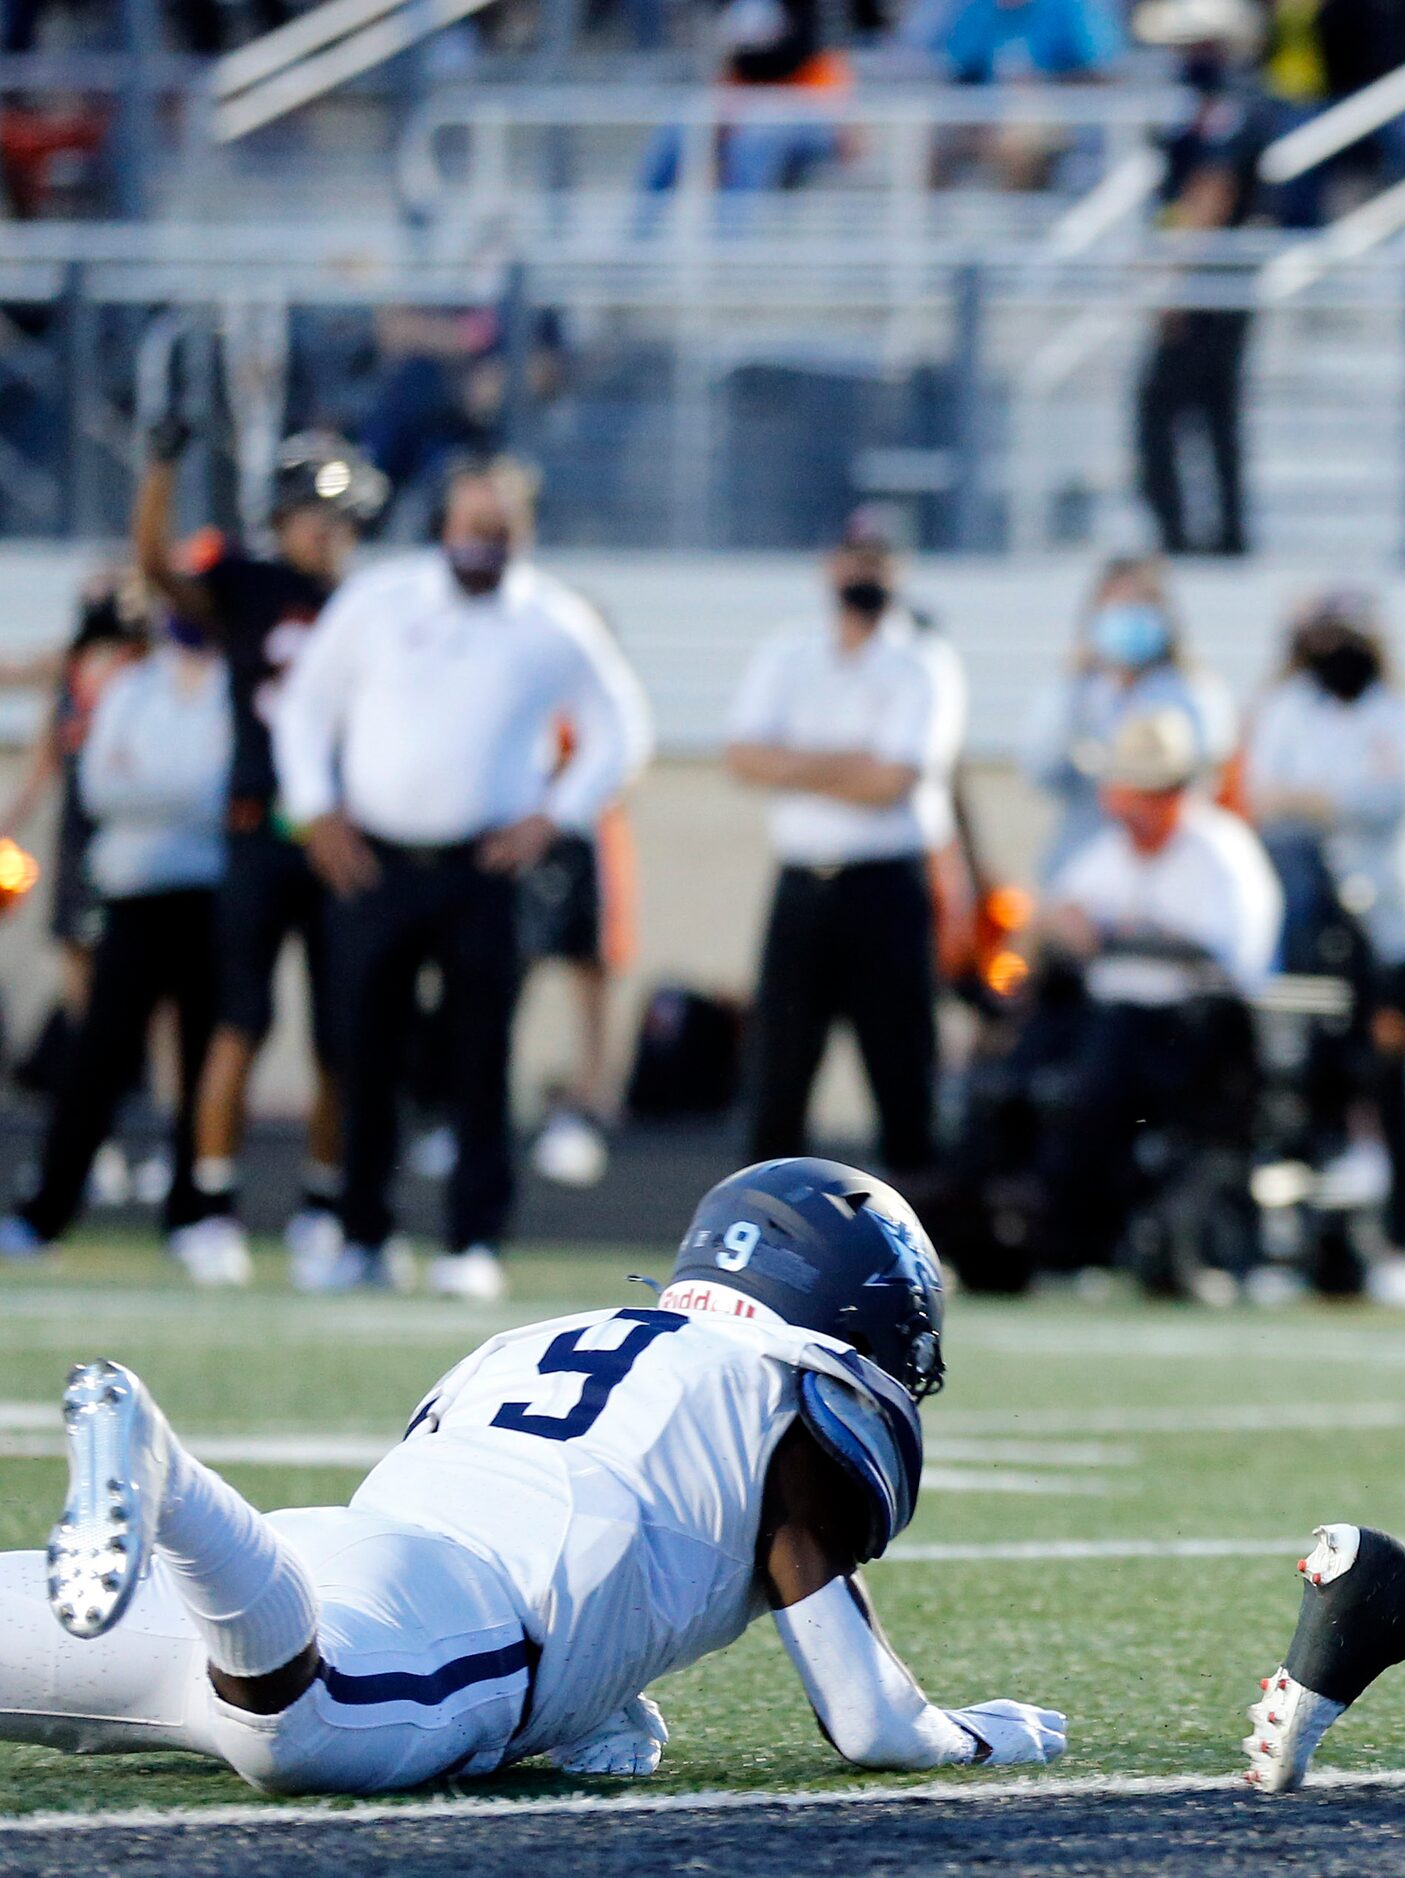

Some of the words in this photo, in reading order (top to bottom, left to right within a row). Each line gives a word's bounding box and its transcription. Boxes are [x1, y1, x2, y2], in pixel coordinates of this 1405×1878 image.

[715, 1220, 761, 1273] 9
[661, 1287, 756, 1319] Riddll
[489, 1308, 690, 1442] 9
